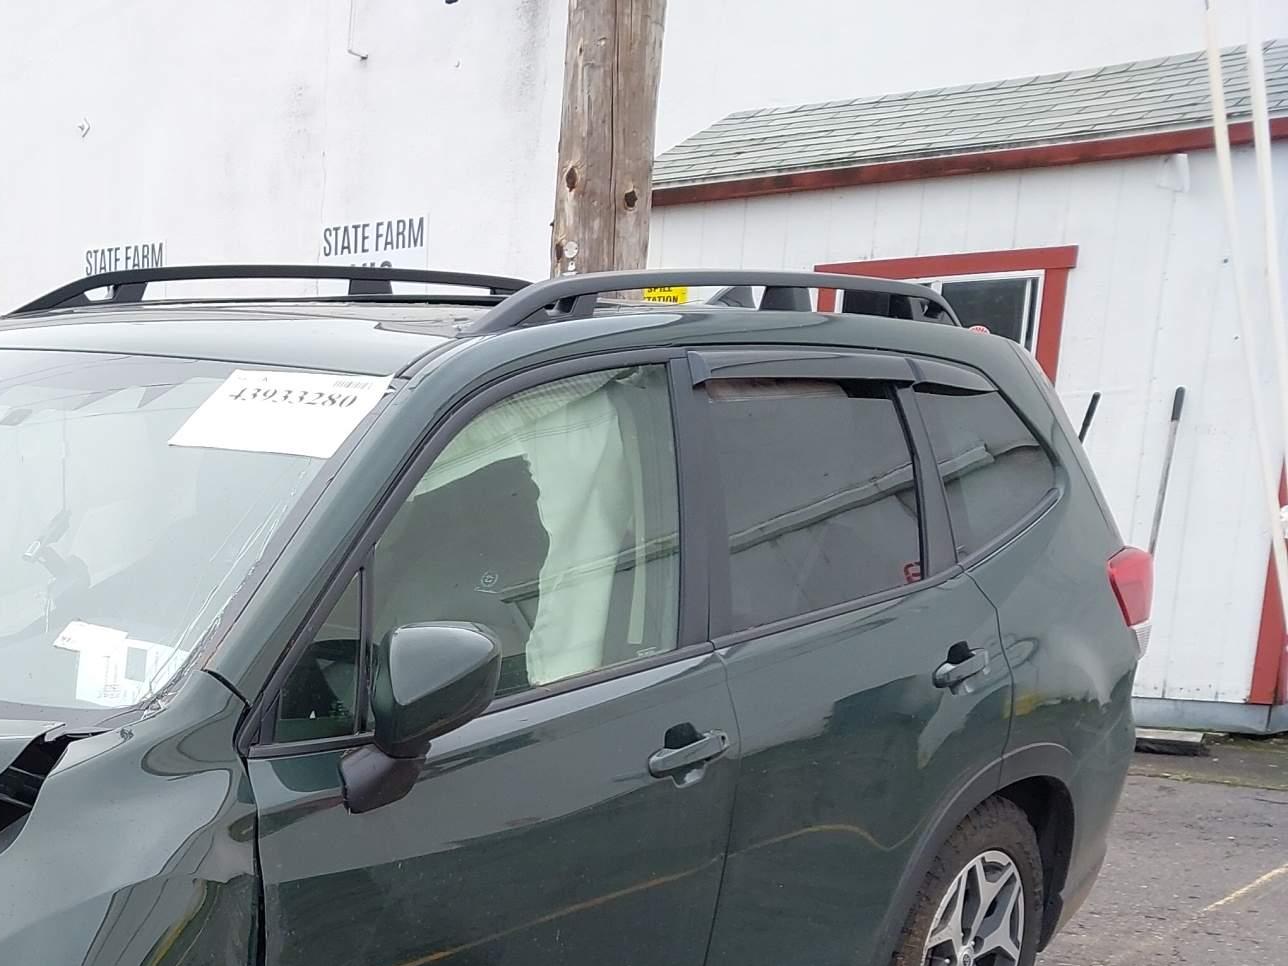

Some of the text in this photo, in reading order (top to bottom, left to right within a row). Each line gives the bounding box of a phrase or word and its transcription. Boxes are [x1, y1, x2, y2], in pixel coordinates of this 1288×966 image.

[323, 216, 424, 257] STATE FARM
[85, 242, 163, 276] STATE FARM
[229, 387, 358, 408] 43933280
